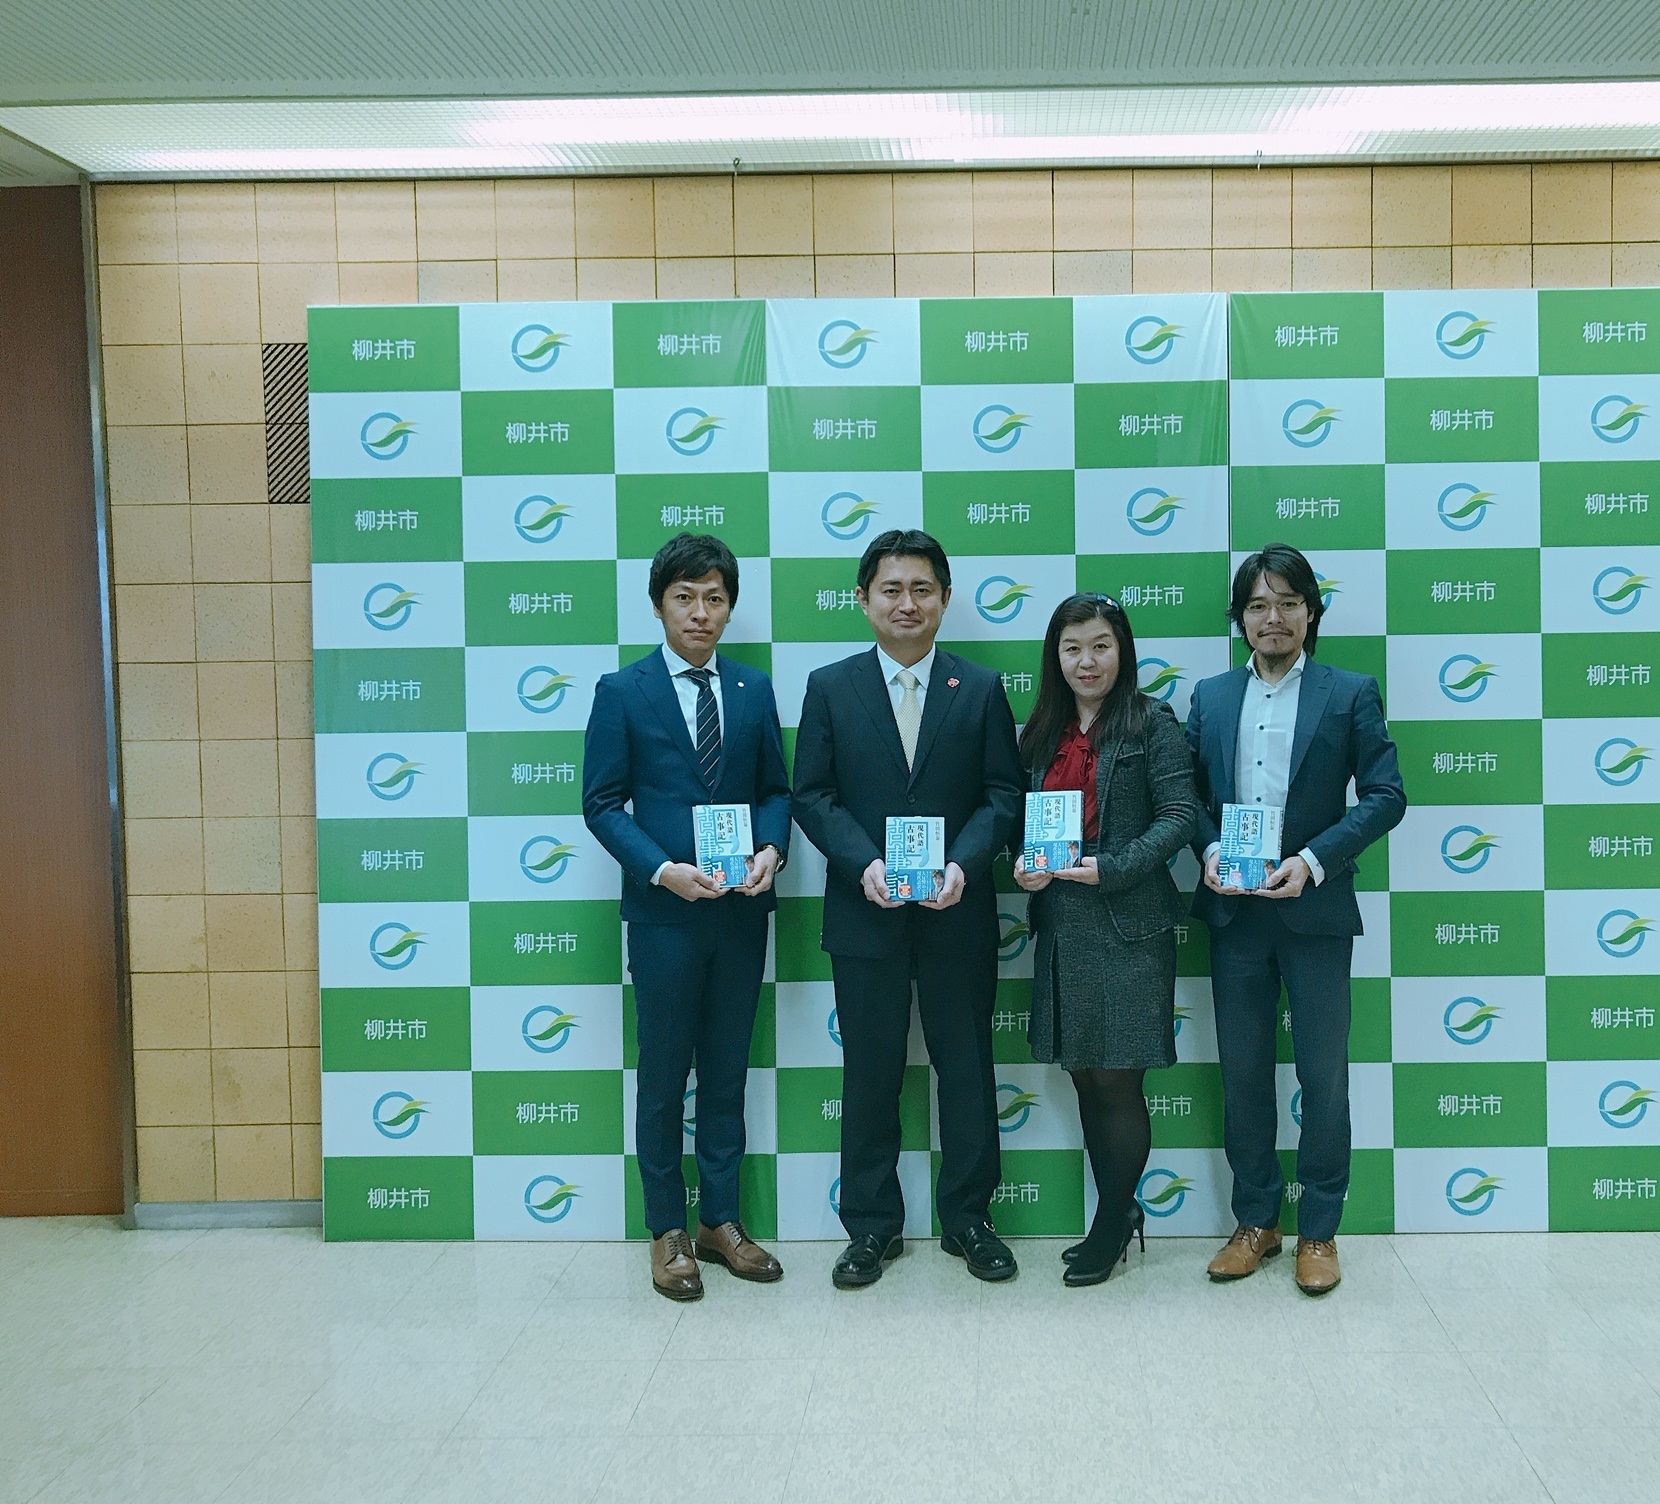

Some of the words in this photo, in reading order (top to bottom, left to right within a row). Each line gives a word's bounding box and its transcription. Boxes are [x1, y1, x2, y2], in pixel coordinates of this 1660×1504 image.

[964, 329, 1030, 353] 柳井市
[1274, 324, 1340, 348] 柳井市
[1582, 320, 1648, 344] 柳井市
[351, 338, 417, 361] 柳井市
[656, 332, 723, 357] 柳井市
[812, 417, 878, 441] 柳井市
[1118, 413, 1184, 437] 柳井市
[1429, 408, 1495, 432] 柳井市
[505, 421, 571, 444] 柳井市
[966, 501, 1031, 525] 柳井市
[1275, 496, 1341, 519] 柳井市
[1584, 492, 1650, 515] 柳井市
[354, 509, 419, 532] 柳井市
[660, 504, 726, 527] 柳井市
[815, 589, 859, 611] 柳井
[1119, 583, 1185, 608] 柳井市
[1431, 580, 1497, 603] 柳井市
[508, 592, 574, 615] 柳井市
[1586, 663, 1652, 687] 柳井市
[358, 679, 422, 702] 柳井市
[511, 762, 576, 785] 柳井市
[1432, 751, 1499, 774] 柳井市
[1043, 798, 1053, 826] 古事記
[716, 812, 726, 841] 古事記
[1240, 812, 1250, 842] 古事記
[906, 824, 916, 854] 古事記
[1588, 835, 1654, 858] 柳井市
[360, 849, 425, 871] 柳井市
[513, 931, 578, 954] 柳井市
[1434, 922, 1501, 945] 柳井市
[991, 1010, 1031, 1032] 井市
[1590, 1006, 1656, 1029] 柳井市
[363, 1018, 428, 1041] 柳井市
[515, 1102, 580, 1124] 柳井市
[1143, 1094, 1192, 1117] 井市
[1437, 1093, 1503, 1117] 柳井市
[367, 1187, 431, 1209] 柳井市
[989, 1181, 1040, 1204] 井市
[1592, 1177, 1658, 1200] 柳井市
